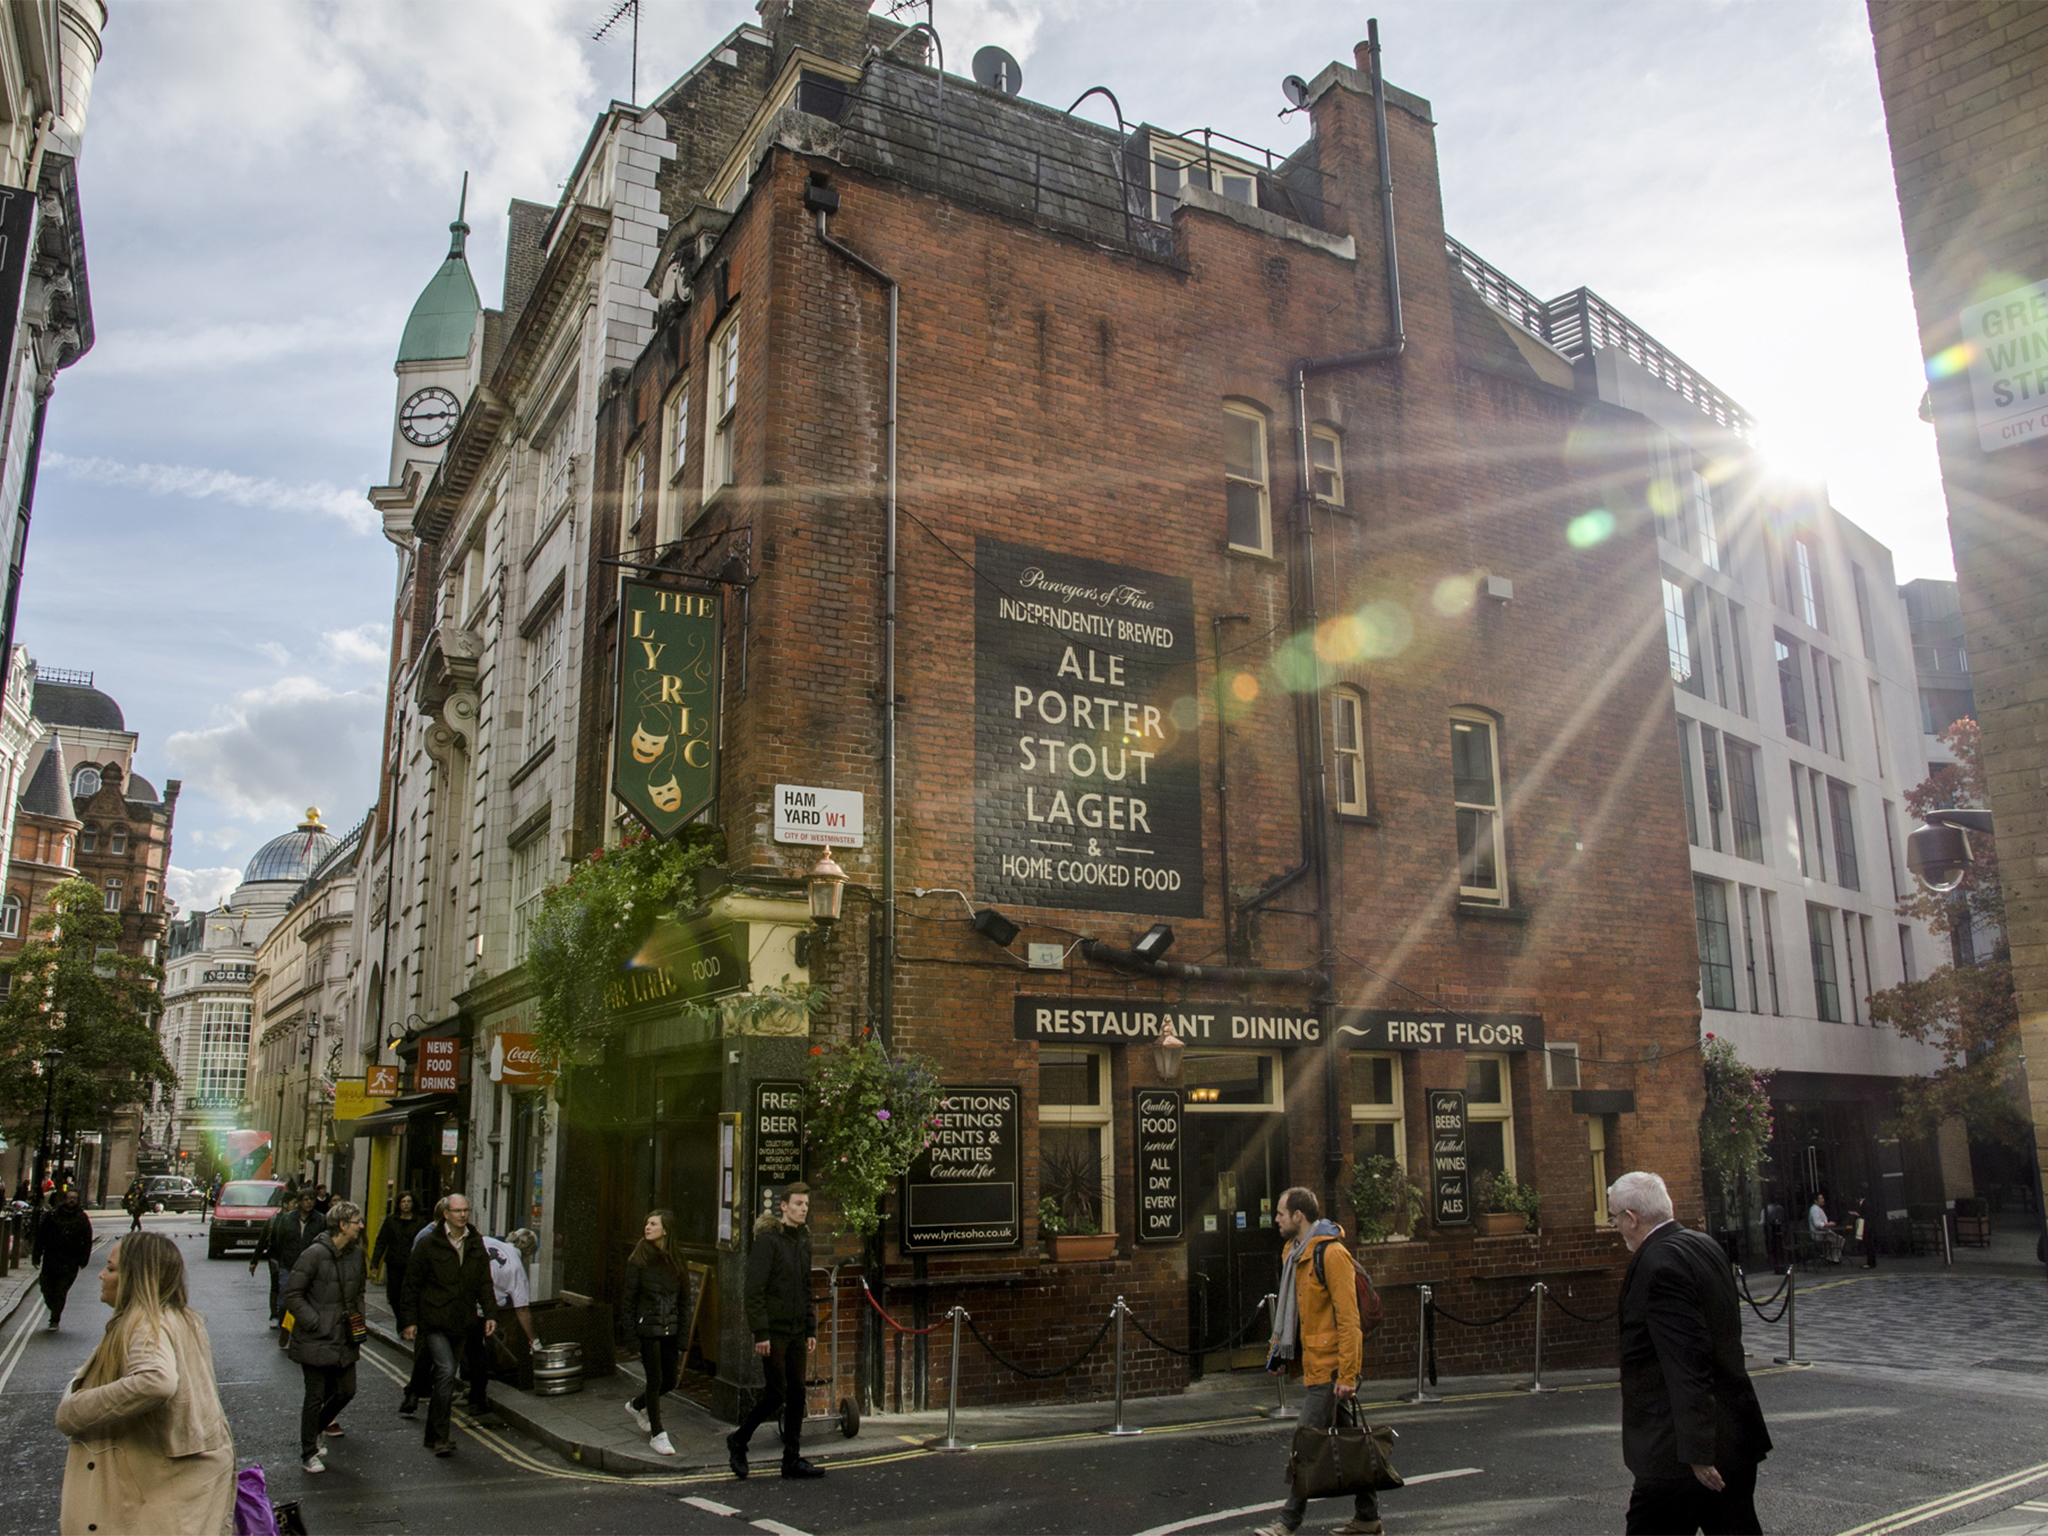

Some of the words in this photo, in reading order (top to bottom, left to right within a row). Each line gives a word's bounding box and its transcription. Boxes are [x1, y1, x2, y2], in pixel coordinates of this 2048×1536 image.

[2001, 417, 2035, 440] CITY
[1019, 566, 1098, 604] Purveyors
[1096, 587, 1119, 608] of
[1115, 584, 1155, 611] Fine
[655, 591, 715, 619] THE
[999, 597, 1115, 639] INDEPENDENTLY
[1117, 619, 1174, 649] BREWED
[1057, 645, 1126, 687] ALE
[630, 609, 711, 769] LYRIC
[1014, 685, 1165, 739] PORTER
[1019, 736, 1155, 785] STOUT
[784, 791, 816, 808] HAM
[784, 808, 821, 825] YARD
[825, 812, 846, 828] W1
[1026, 786, 1152, 834] LAGER
[784, 832, 799, 840] CITY
[800, 833, 809, 841] OF
[811, 834, 856, 844] WESTMINSTER
[1087, 838, 1101, 857] &
[1002, 854, 1053, 881] HOME
[1057, 860, 1130, 888] COOKED
[1134, 866, 1182, 892] FOOD
[691, 956, 721, 982] FOOD
[1036, 1008, 1215, 1039] RESTAURANT
[1231, 1015, 1320, 1041] DINING
[1387, 1021, 1445, 1043] FIRST
[1456, 1023, 1525, 1045] FLOOR
[427, 1041, 454, 1054] NEWS
[426, 1059, 452, 1072] FOOD
[421, 1077, 456, 1090] DRINKS
[1140, 1098, 1176, 1116] Quality
[1436, 1098, 1458, 1113] Craft
[760, 1116, 798, 1133] BEER
[934, 1113, 1003, 1128] EETINGS
[1141, 1118, 1177, 1134] FOOD
[1435, 1115, 1462, 1129] BEERS
[988, 1130, 1002, 1145] &
[1143, 1138, 1177, 1151] served
[931, 1146, 993, 1162] PARTIES
[1434, 1140, 1465, 1153] Chilled
[930, 1162, 979, 1179] Catered
[976, 1163, 996, 1179] for
[1150, 1158, 1171, 1171] ALL
[1435, 1157, 1466, 1170] WINES
[1149, 1176, 1171, 1190] DAY
[1440, 1182, 1463, 1195] Cask
[1144, 1196, 1177, 1209] EVERY
[1442, 1199, 1463, 1214] ALES
[1149, 1215, 1172, 1228] DAY
[912, 1227, 1012, 1243] www.lyricsoho.co.uk
